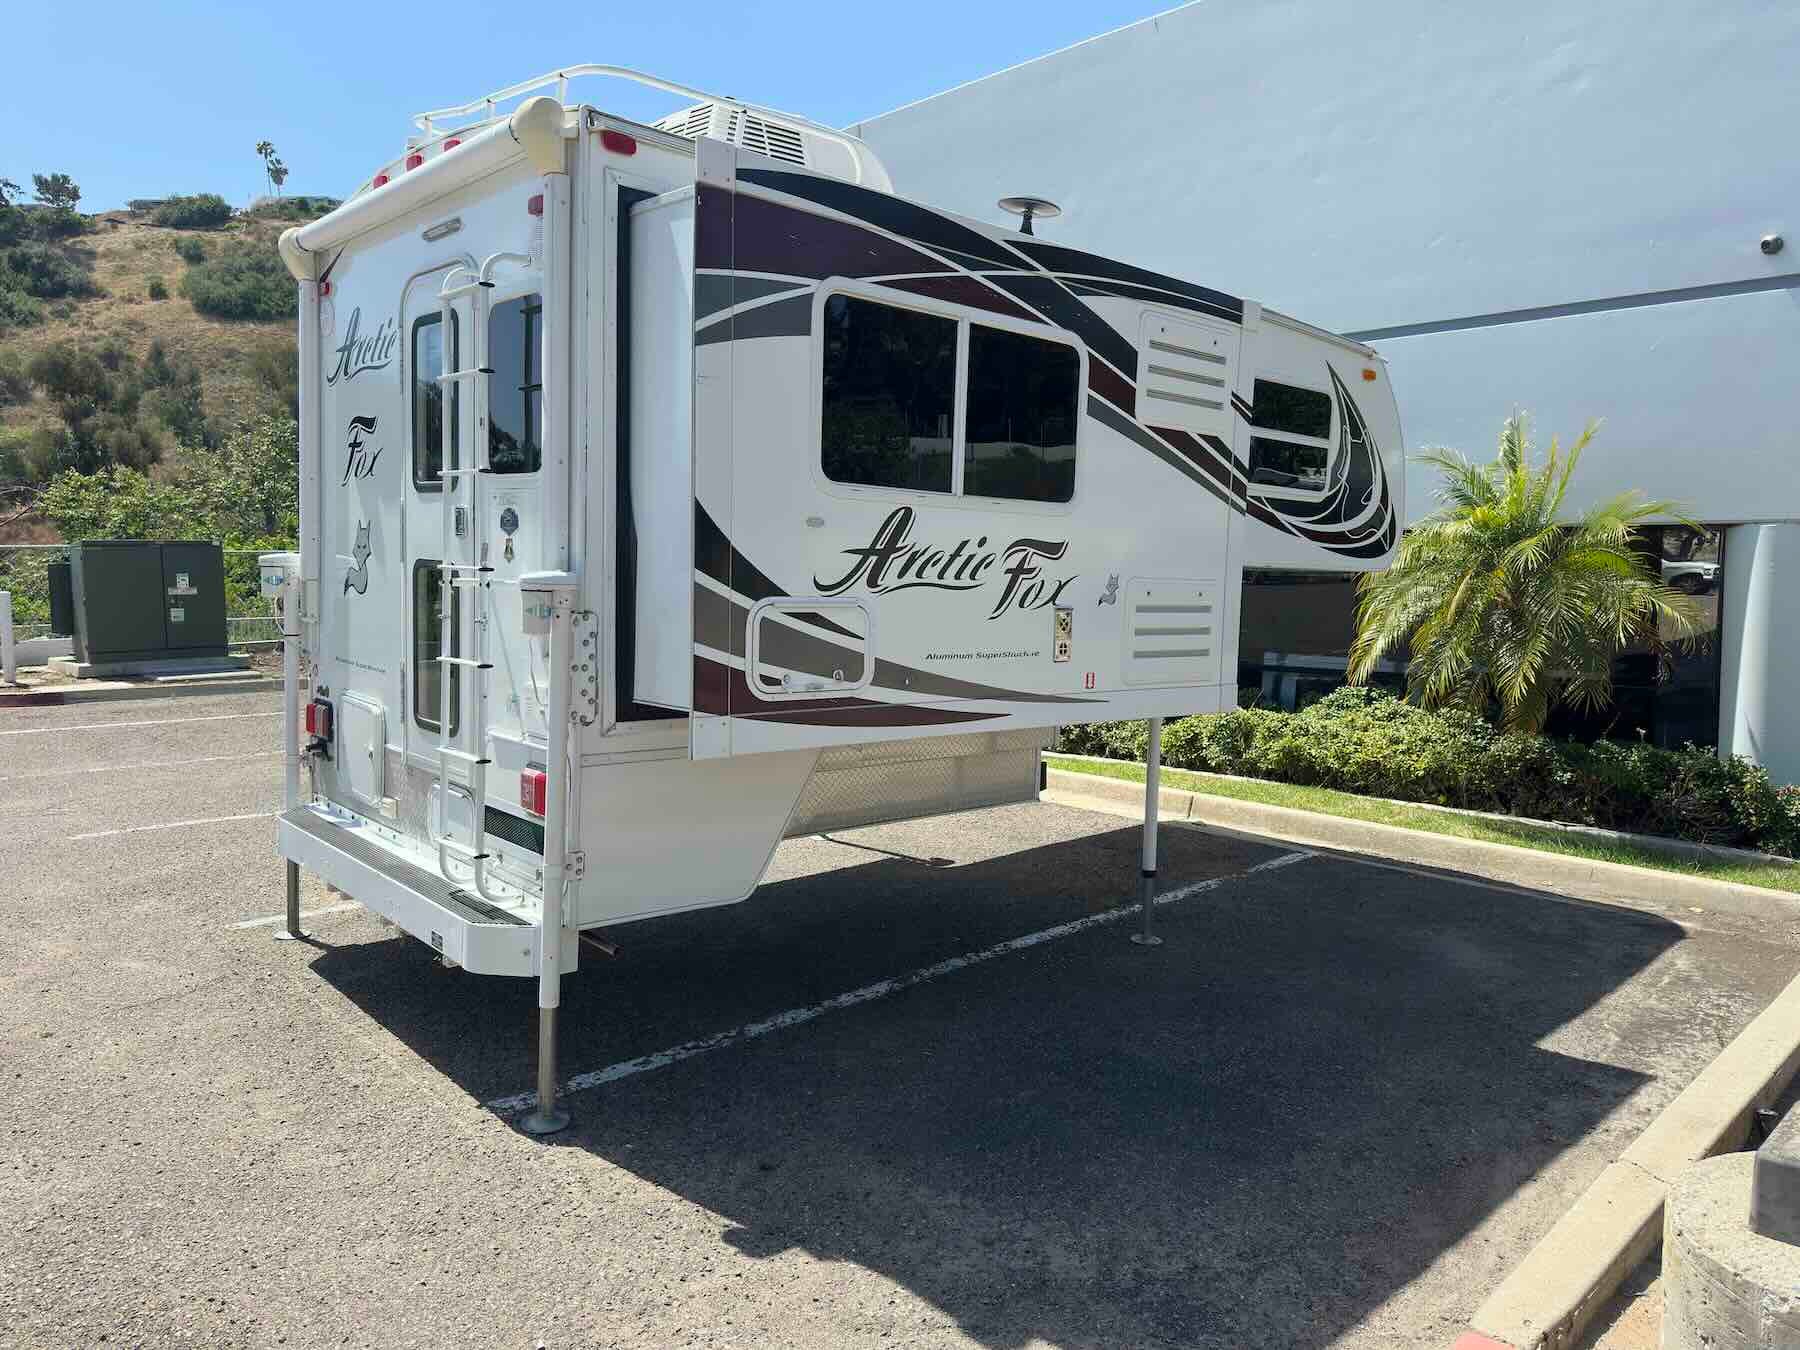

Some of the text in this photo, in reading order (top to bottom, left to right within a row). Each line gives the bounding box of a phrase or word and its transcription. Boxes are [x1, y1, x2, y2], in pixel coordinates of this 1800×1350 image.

[327, 306, 397, 386] Arctic
[341, 416, 384, 487] Fox
[813, 505, 1079, 621] Arctic Fox
[925, 652, 974, 661] Aluminum
